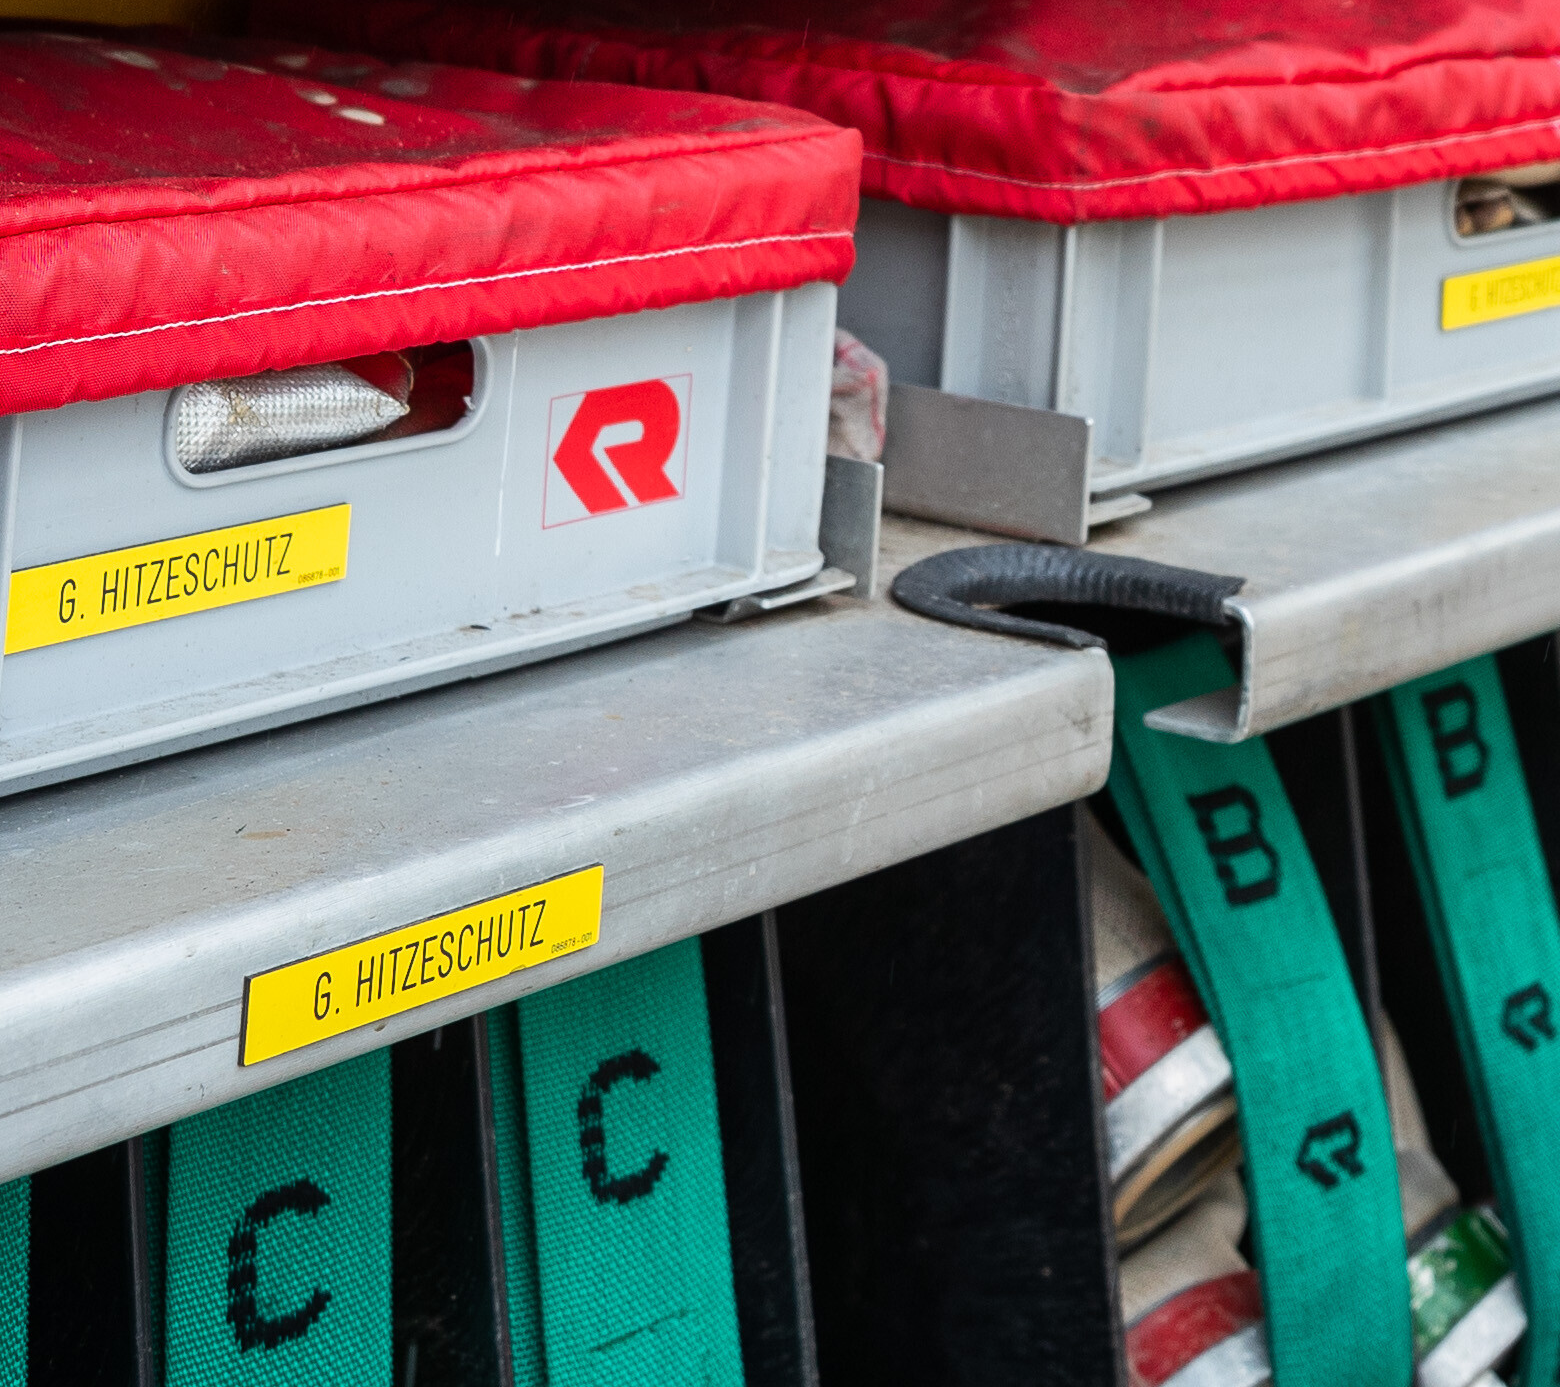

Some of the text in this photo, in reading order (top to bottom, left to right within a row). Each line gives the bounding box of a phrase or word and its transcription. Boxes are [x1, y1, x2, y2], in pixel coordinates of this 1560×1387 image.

[58, 532, 294, 624] G. HITZESCHUTZ
[1420, 682, 1491, 801] B
[1187, 783, 1283, 909] B
[313, 899, 547, 1020] G. HITZESCHUTZ
[577, 1049, 669, 1205] C
[225, 1178, 334, 1353] C
